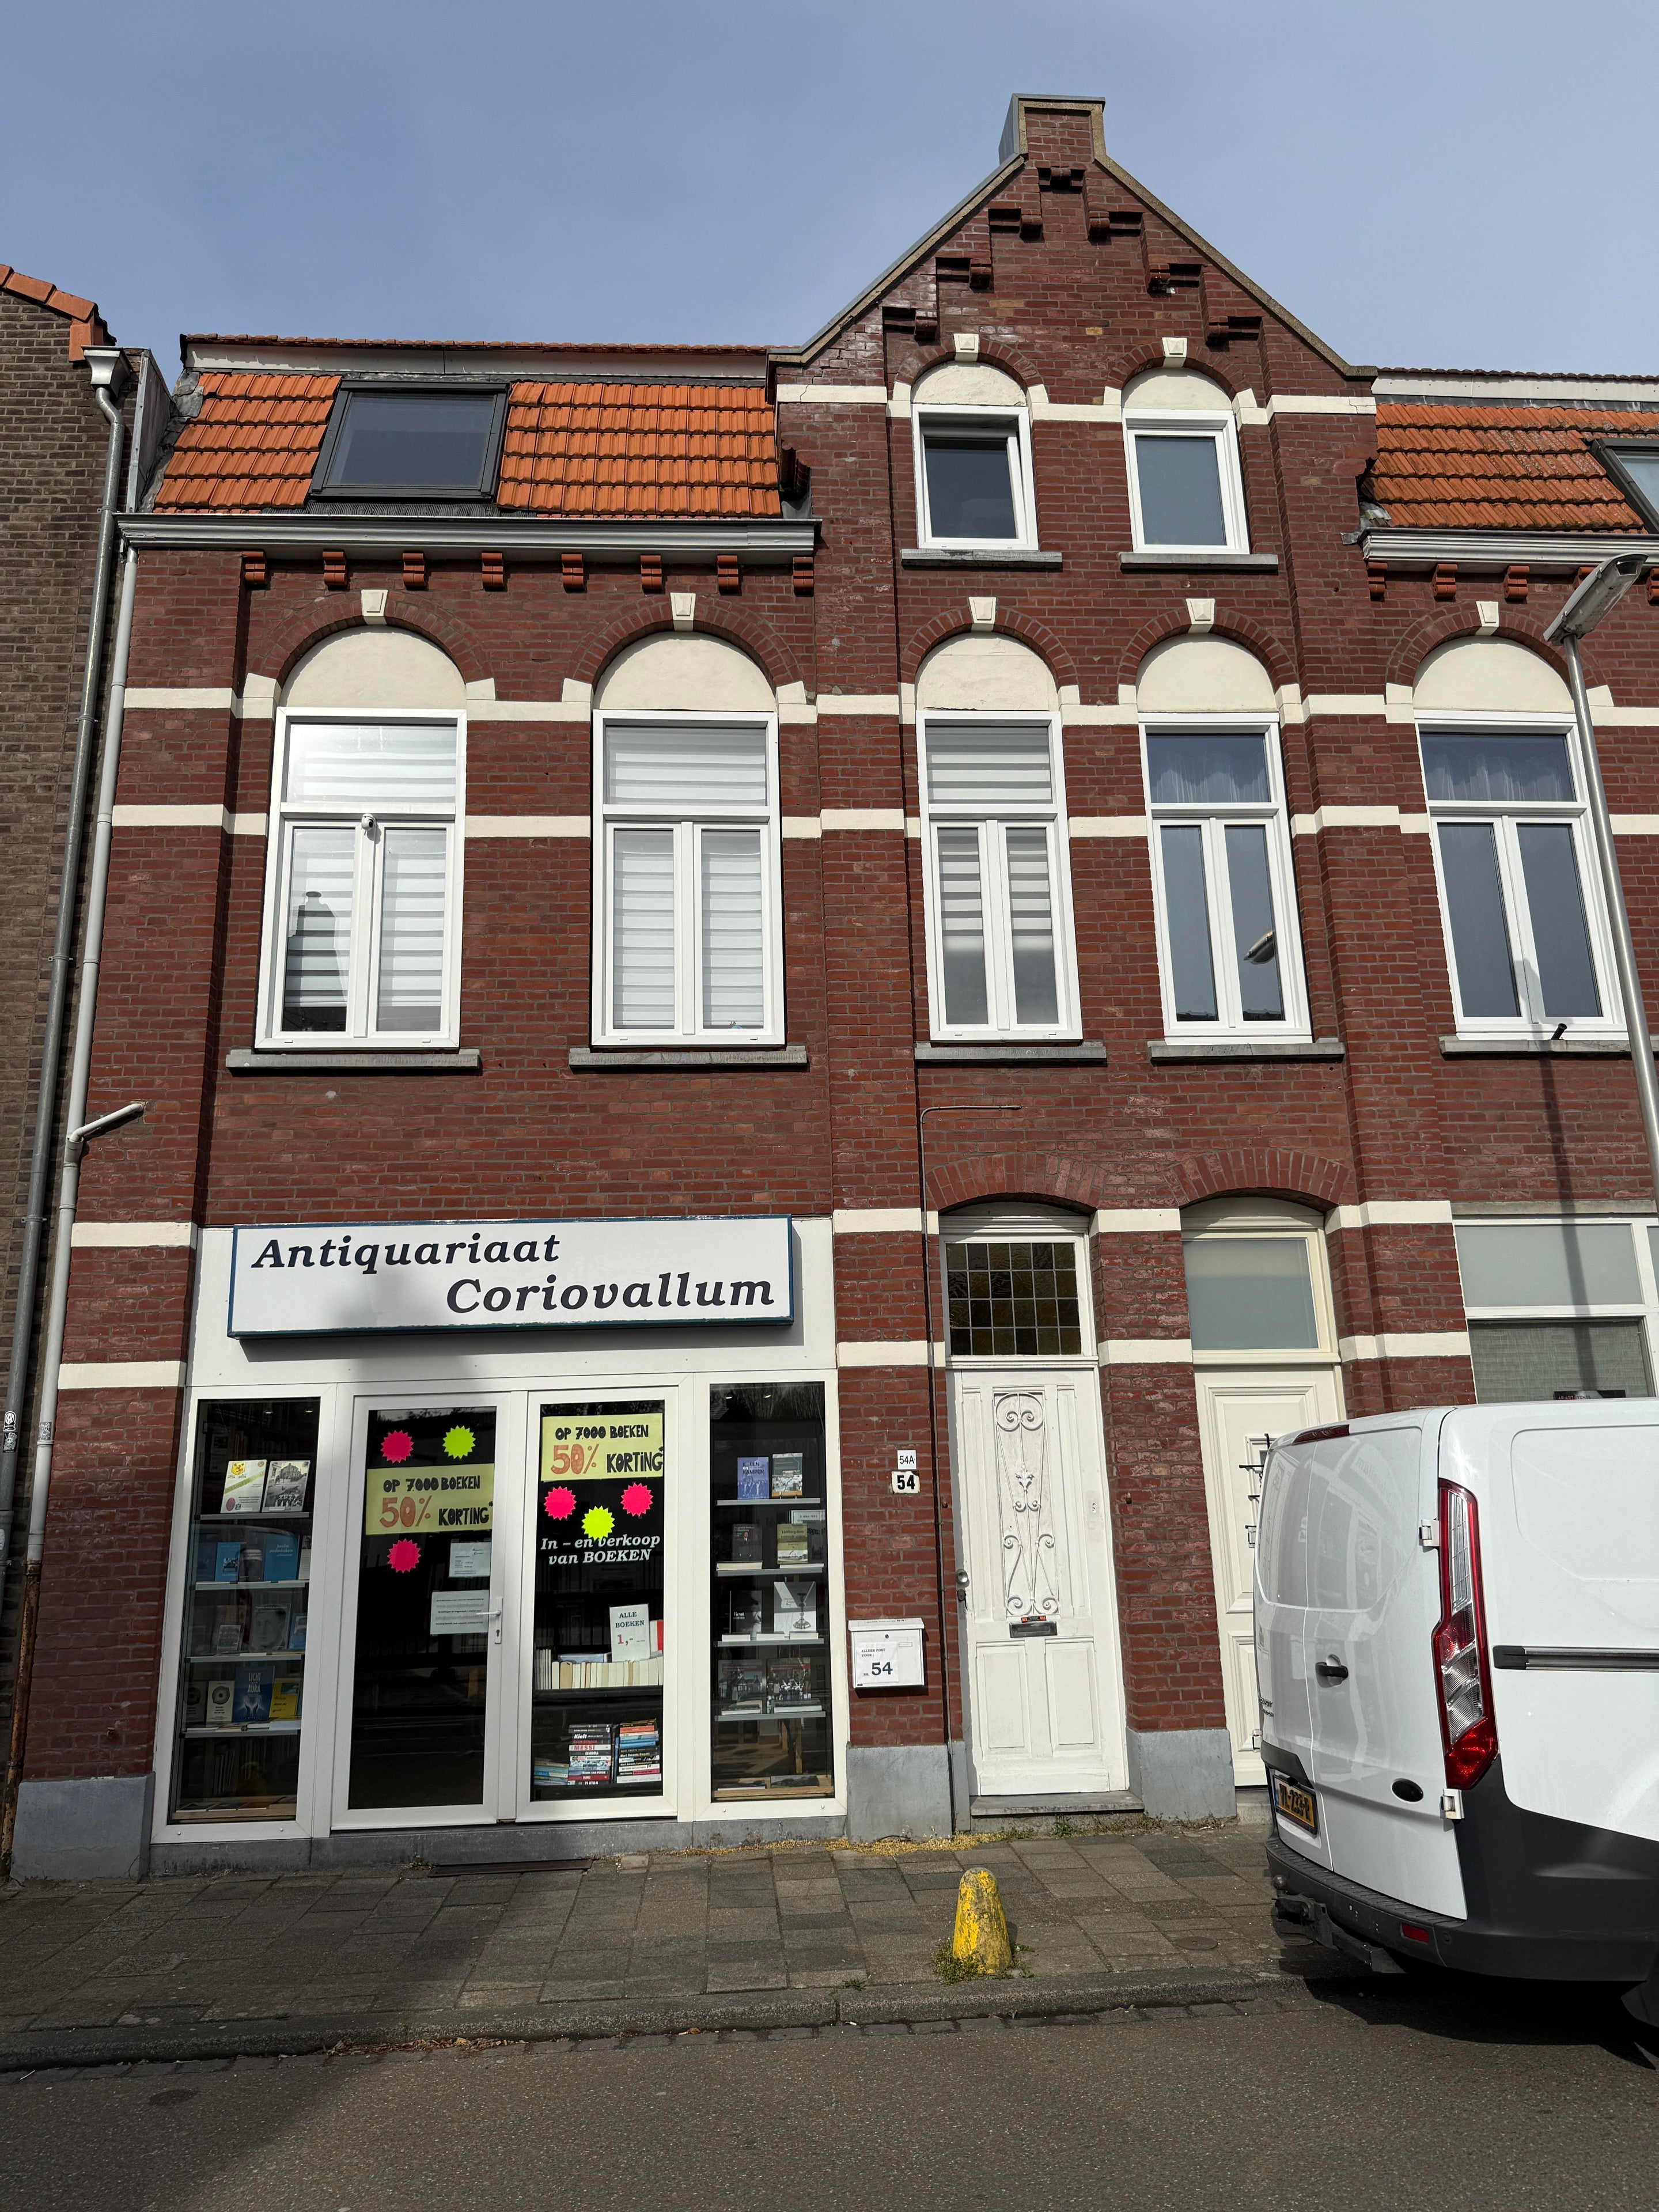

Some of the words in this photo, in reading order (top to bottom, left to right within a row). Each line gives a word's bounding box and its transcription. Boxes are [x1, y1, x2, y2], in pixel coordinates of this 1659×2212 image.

[251, 1233, 560, 1274] Antiquariaat
[446, 1272, 775, 1313] Coriovallum
[555, 1427, 571, 1440] OP
[610, 1425, 649, 1438] BOEKEN
[551, 1444, 599, 1475] 50%
[899, 1455, 915, 1464] 54A
[383, 1479, 400, 1493] OP
[441, 1475, 480, 1490] BOEKEN
[897, 1475, 915, 1490] 54
[379, 1495, 432, 1527] 50%
[541, 1538, 558, 1550] In
[574, 1539, 593, 1548] en
[598, 1534, 660, 1548] verkoop
[548, 1555, 578, 1565] van
[582, 1549, 652, 1563] BOEKEN
[615, 1620, 645, 1628] BOEKEN
[871, 1661, 893, 1676] 54
[248, 1672, 262, 1681] LICHT
[247, 1684, 261, 1693] AURA
